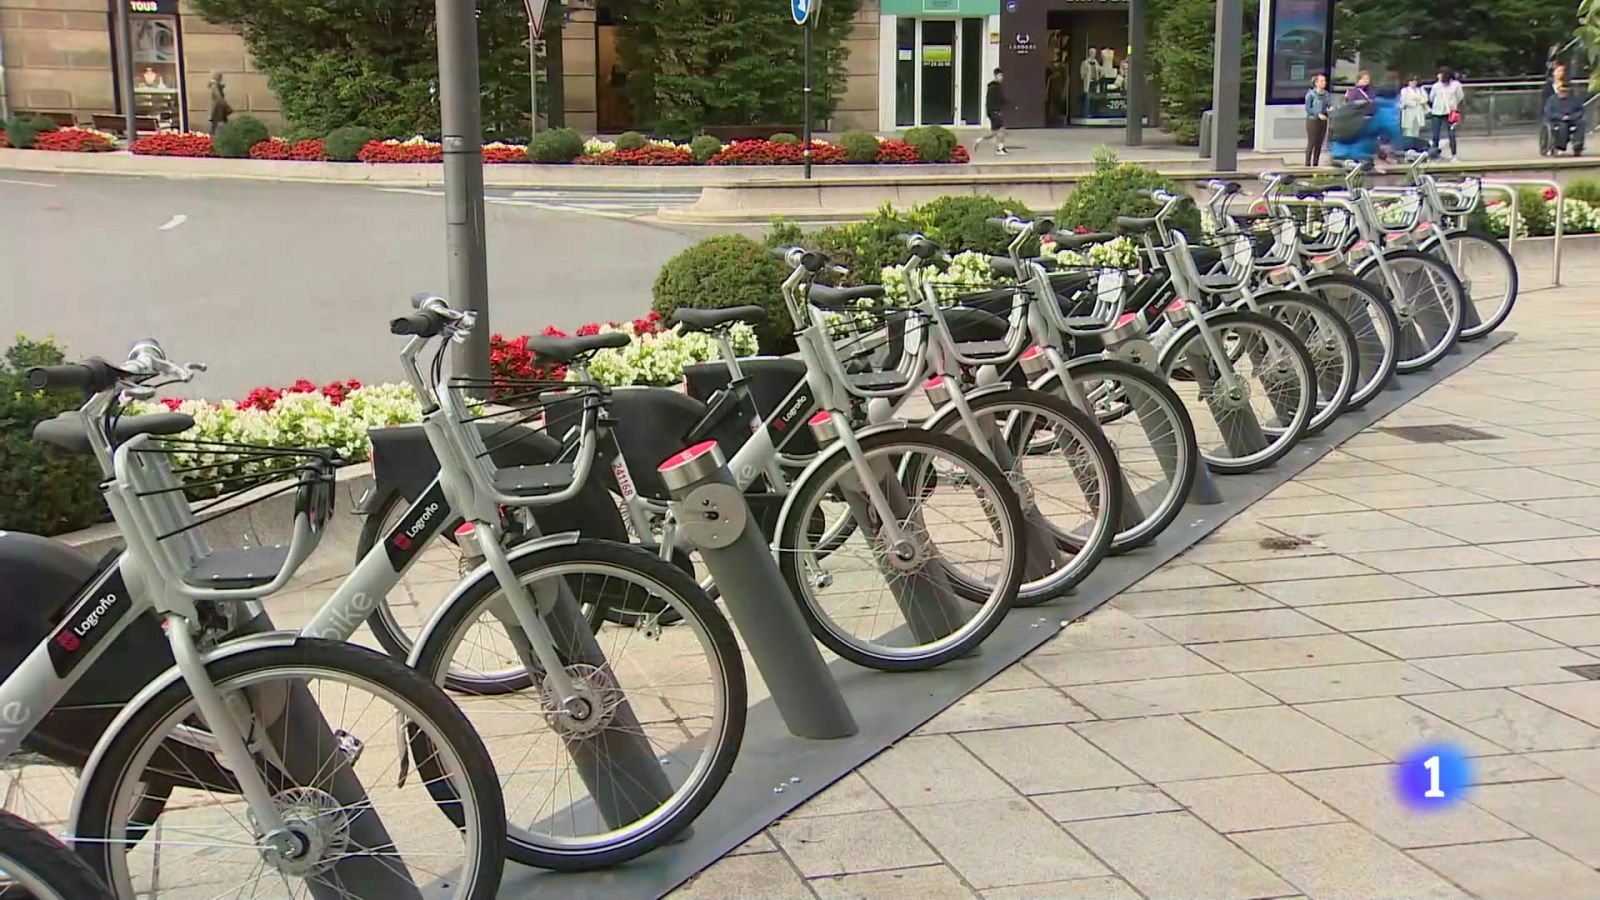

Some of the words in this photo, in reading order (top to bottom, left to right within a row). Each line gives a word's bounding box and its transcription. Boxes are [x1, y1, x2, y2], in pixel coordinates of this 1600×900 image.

[130, 1, 157, 12] TOUS
[612, 463, 633, 497] 241168
[406, 502, 439, 538] Logroño
[74, 593, 117, 636] Logroño
